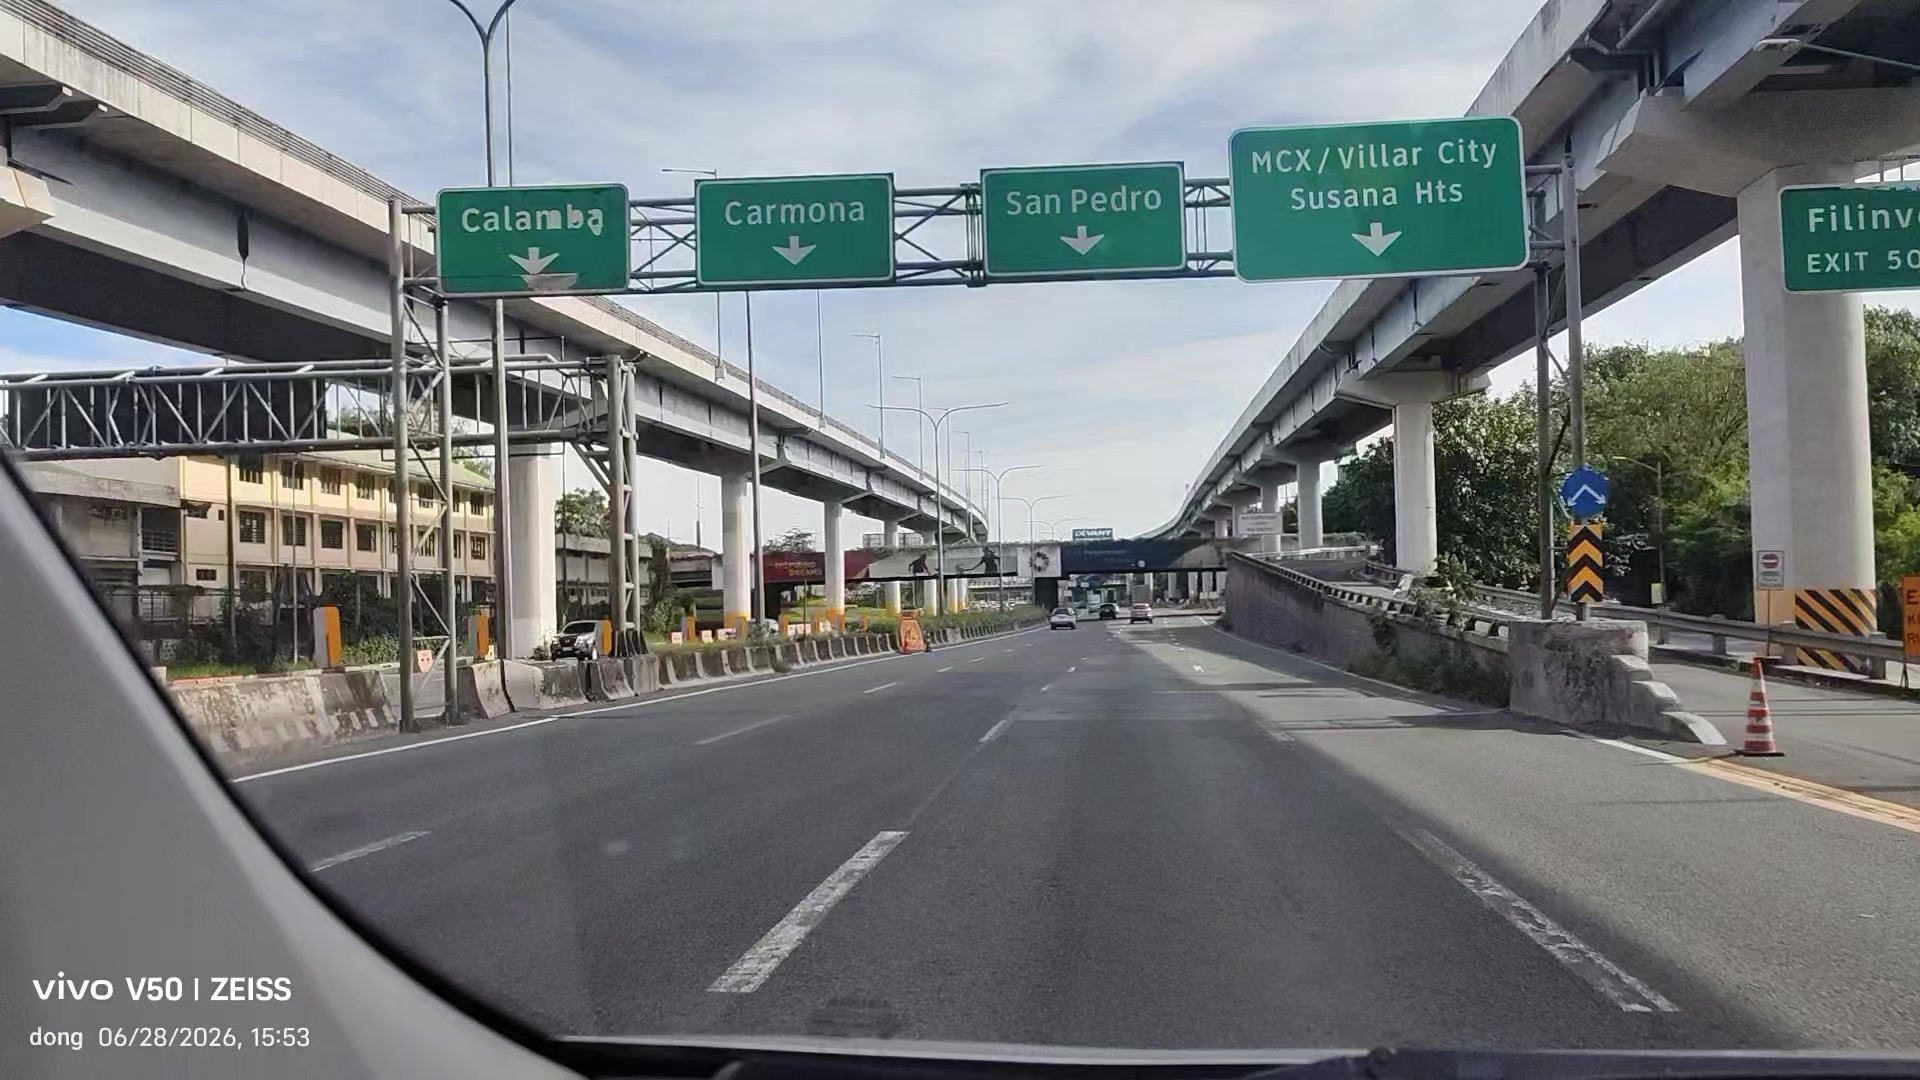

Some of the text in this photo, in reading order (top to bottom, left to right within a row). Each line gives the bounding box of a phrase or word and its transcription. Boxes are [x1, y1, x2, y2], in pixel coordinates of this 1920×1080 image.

[1438, 137, 1498, 169] City
[1005, 186, 1162, 216] San Pedro
[1290, 180, 1464, 211] Susana Hts
[461, 203, 604, 236] Calamba
[724, 200, 865, 226] Carmona
[1808, 203, 1920, 232] Filinv
[1807, 248, 1920, 273] EXIT 50
